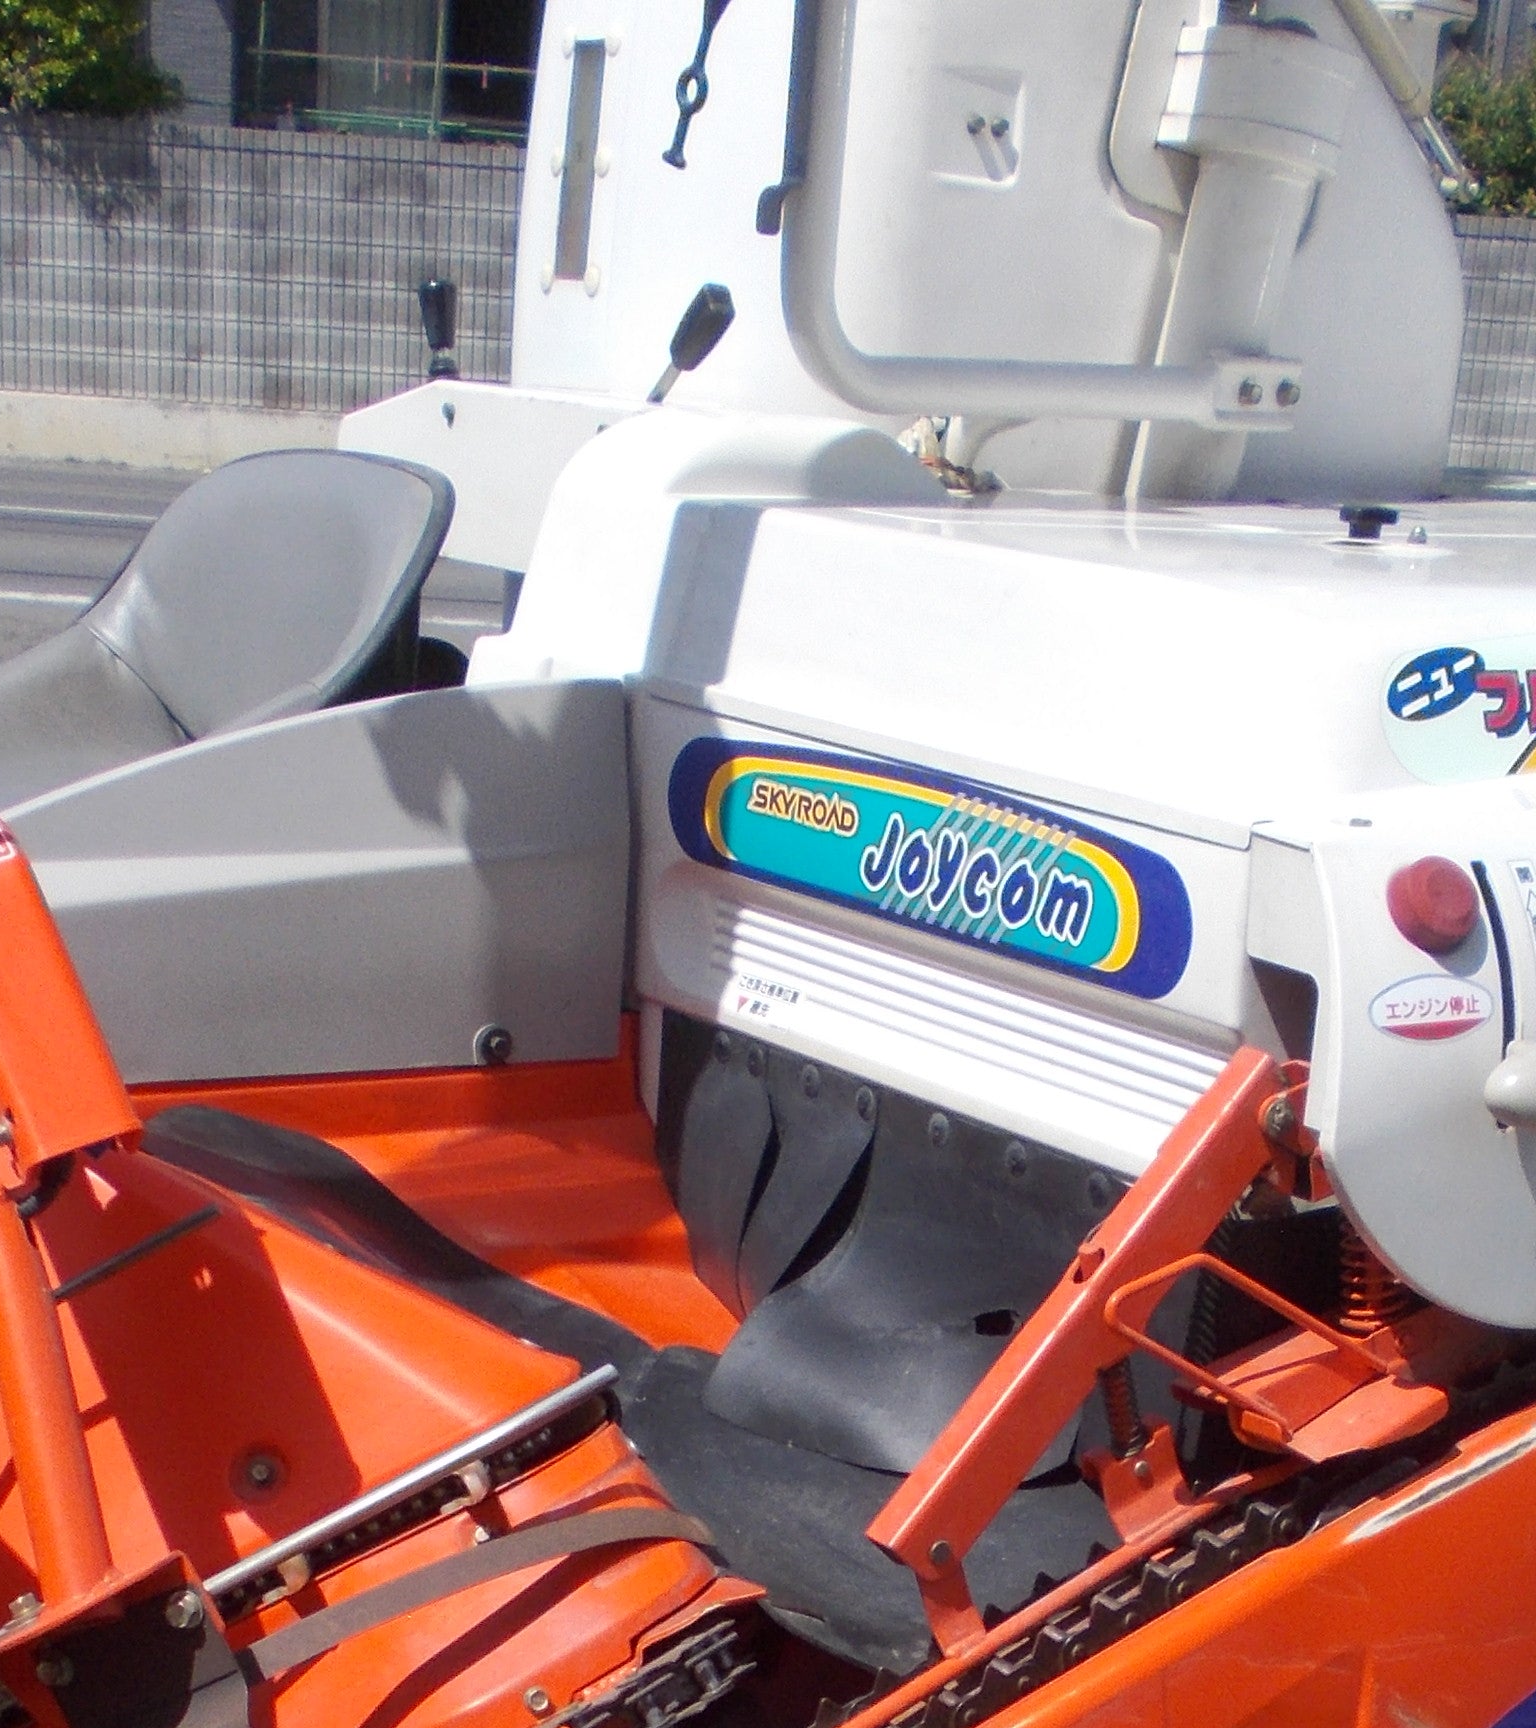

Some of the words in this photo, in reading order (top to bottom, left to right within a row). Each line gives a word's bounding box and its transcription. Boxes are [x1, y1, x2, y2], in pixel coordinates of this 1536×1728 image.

[1396, 652, 1477, 718] ニュー
[748, 780, 859, 836] SKYROAD
[860, 812, 1092, 946] Joycom
[1385, 994, 1481, 1020] エンジン停止
